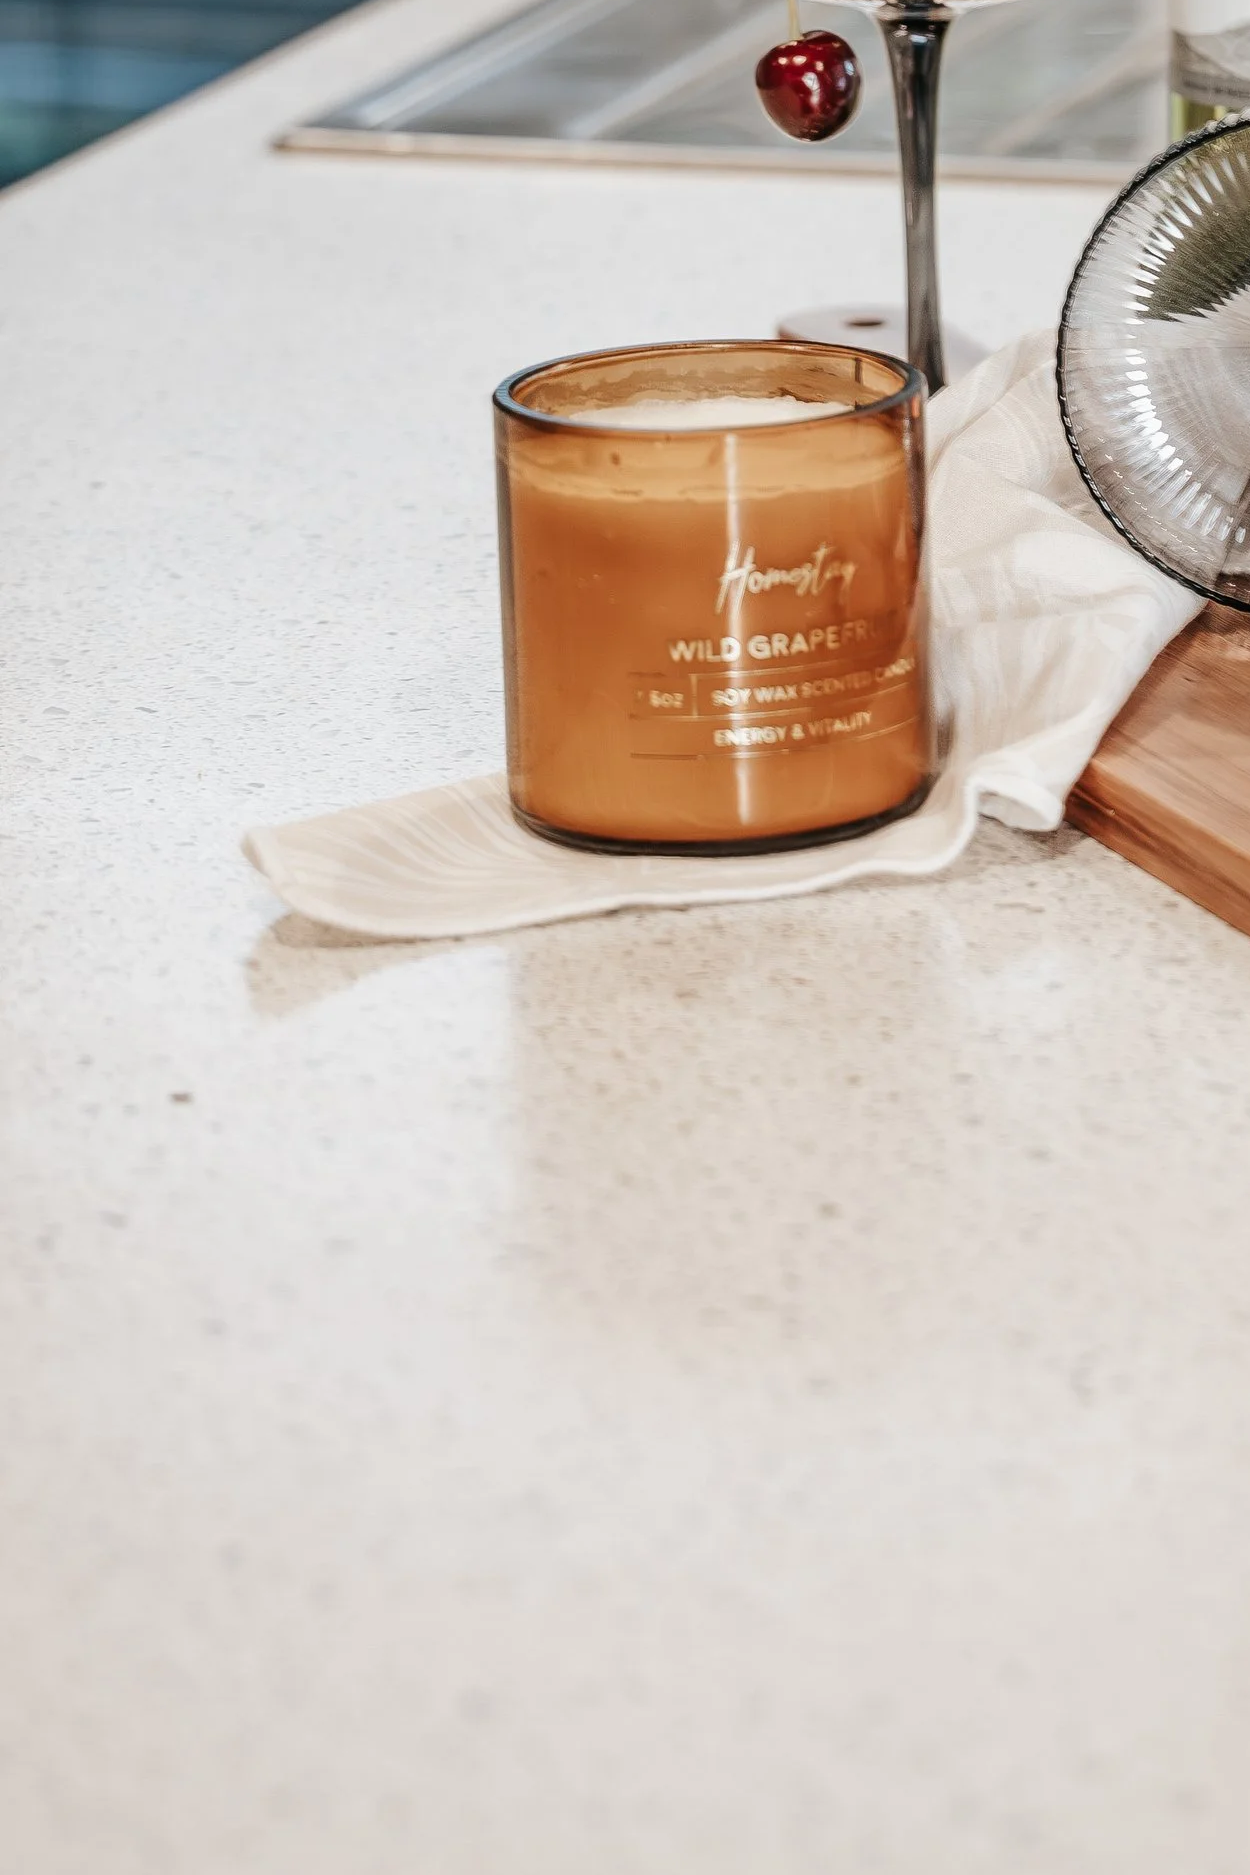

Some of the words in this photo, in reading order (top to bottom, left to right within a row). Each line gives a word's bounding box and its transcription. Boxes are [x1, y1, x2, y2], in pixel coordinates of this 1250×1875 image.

[668, 636, 741, 663] WILD
[748, 618, 876, 660] GRAPEFR
[711, 686, 751, 707] SOY
[753, 683, 798, 704] WAX
[713, 725, 787, 747] ENERGY
[791, 723, 805, 741] &
